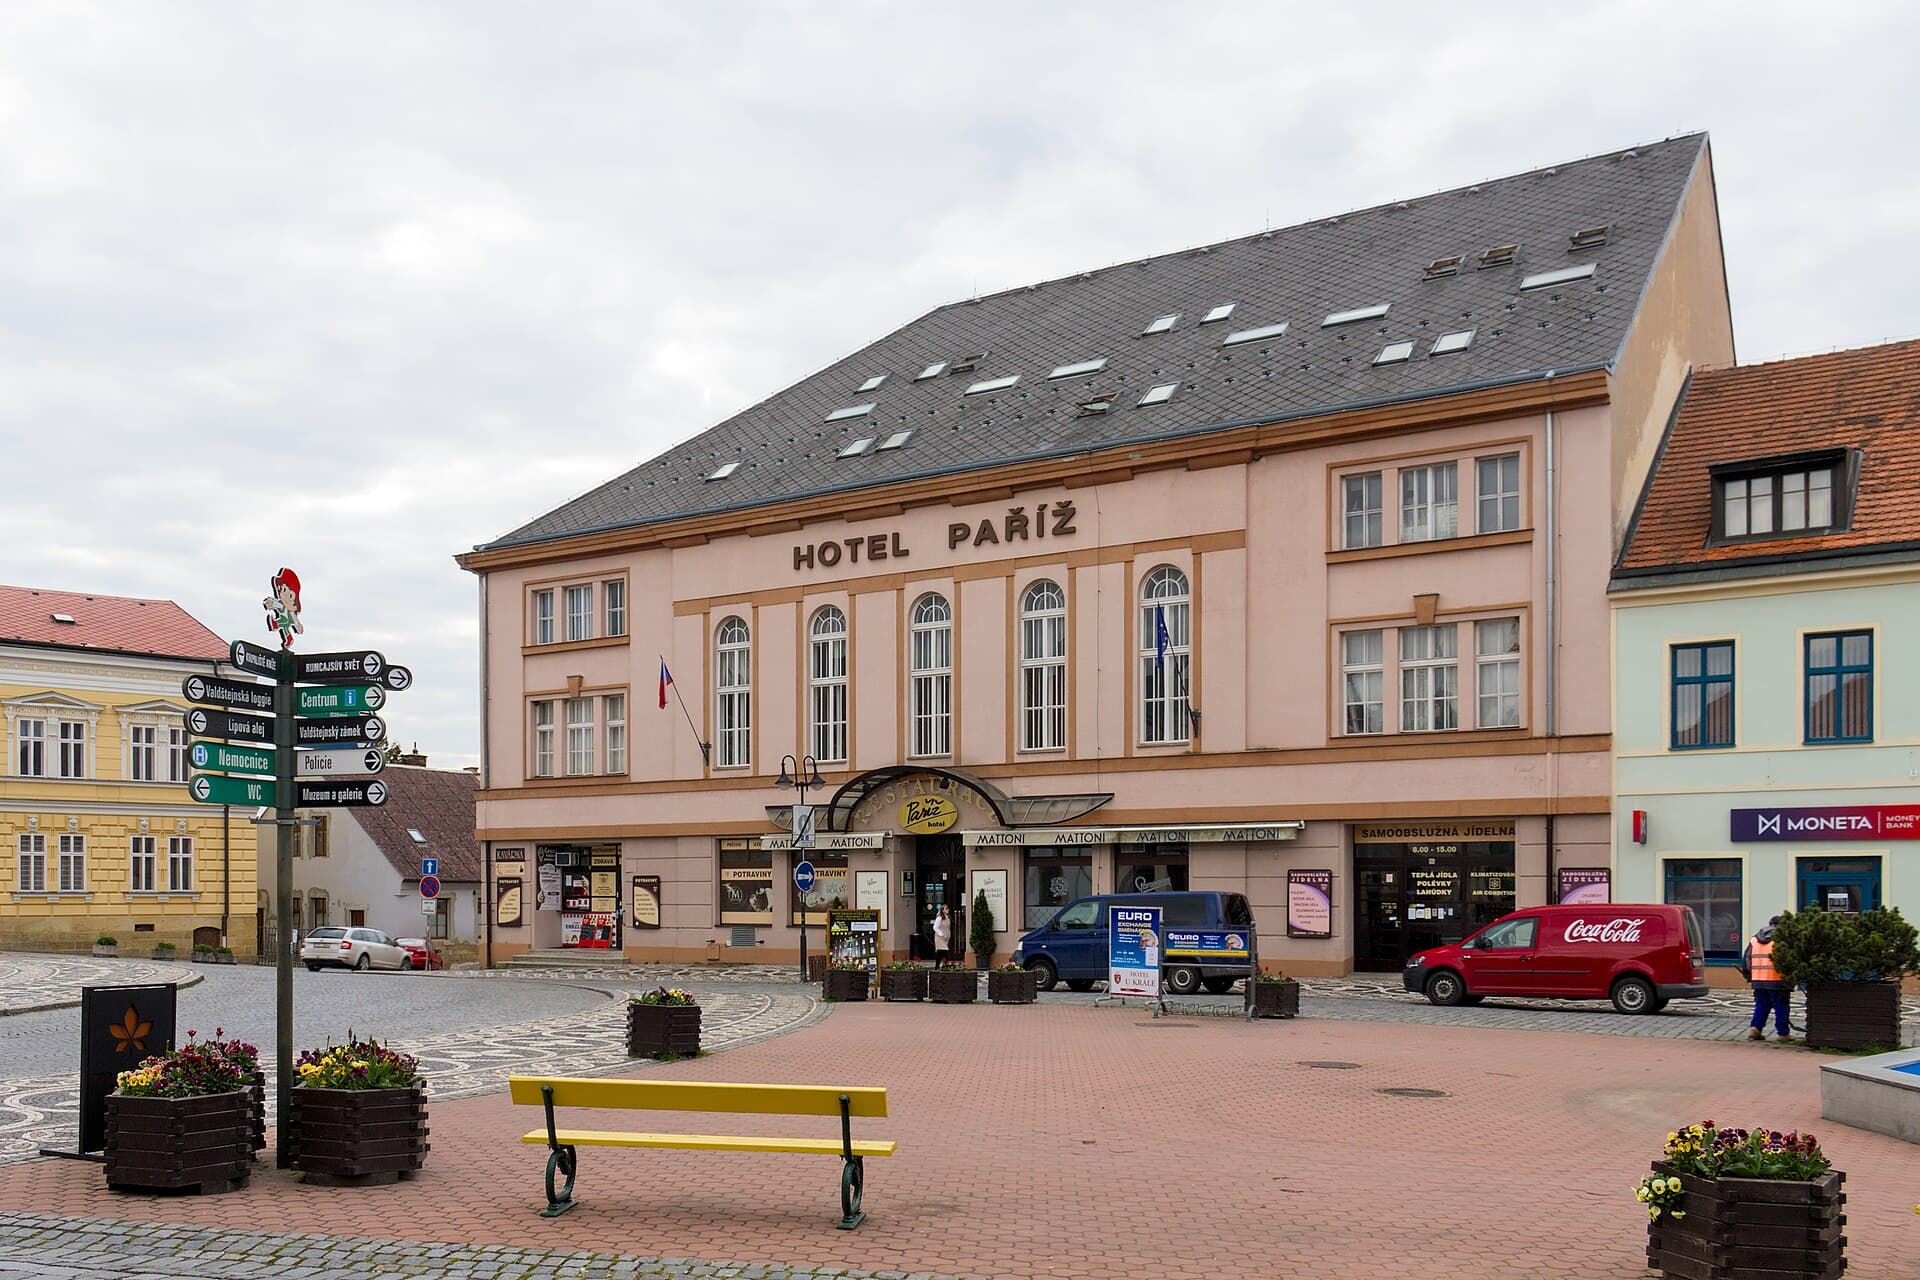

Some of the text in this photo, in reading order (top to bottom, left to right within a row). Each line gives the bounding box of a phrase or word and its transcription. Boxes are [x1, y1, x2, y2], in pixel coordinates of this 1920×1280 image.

[793, 500, 1076, 570] HOTEL PAŘÍŽ
[306, 658, 360, 672] RUMCAJSŮV SVĚT
[206, 684, 271, 707] Valdštejnská loggie
[302, 692, 337, 707] Centrum
[228, 718, 265, 736] Lipová alej
[300, 724, 361, 740] Valdštejnský zámek
[219, 748, 268, 770] Nemocnice
[305, 755, 332, 770] Policie
[248, 784, 262, 800] WC
[303, 787, 362, 803] Muzeum a galerie
[1787, 816, 1872, 830] MONETA
[977, 833, 1025, 844] MATTONI
[1054, 832, 1105, 843] MATTONI
[1136, 831, 1190, 842] MATTONI
[1223, 828, 1280, 840] MATTONI
[1362, 825, 1515, 838] SAMOOBSLUŽNÁ JÍDELNA
[831, 837, 873, 847] MATTONI
[1118, 912, 1152, 920] EURO
